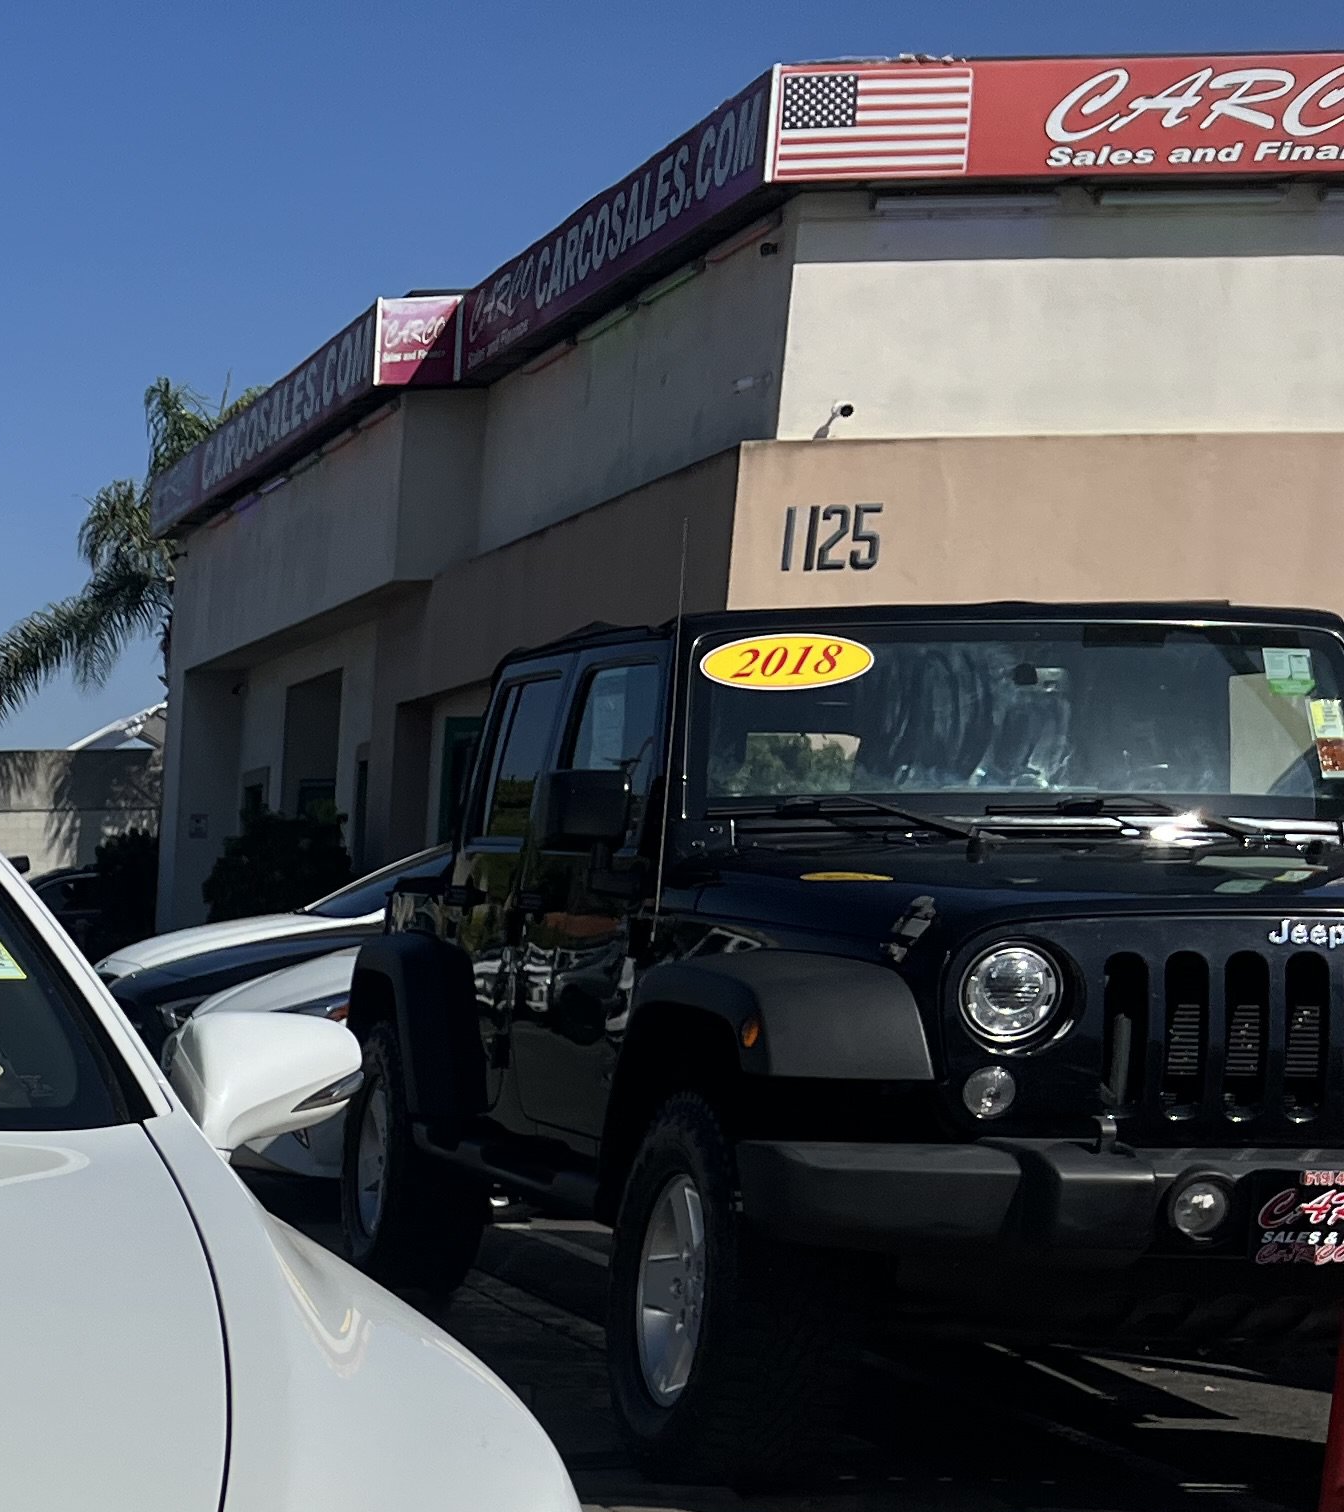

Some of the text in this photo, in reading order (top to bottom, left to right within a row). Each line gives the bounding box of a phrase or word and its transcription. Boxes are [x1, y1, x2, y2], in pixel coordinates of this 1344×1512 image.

[1047, 147, 1155, 167] Sales
[1168, 142, 1244, 164] and
[535, 92, 762, 310] CARCOSALES.COM
[201, 315, 373, 491] CARCOSALES.COM
[780, 503, 884, 572] 1125
[730, 643, 843, 679] 2018
[1268, 919, 1344, 949] Jeep
[1261, 1231, 1322, 1245] SALES
